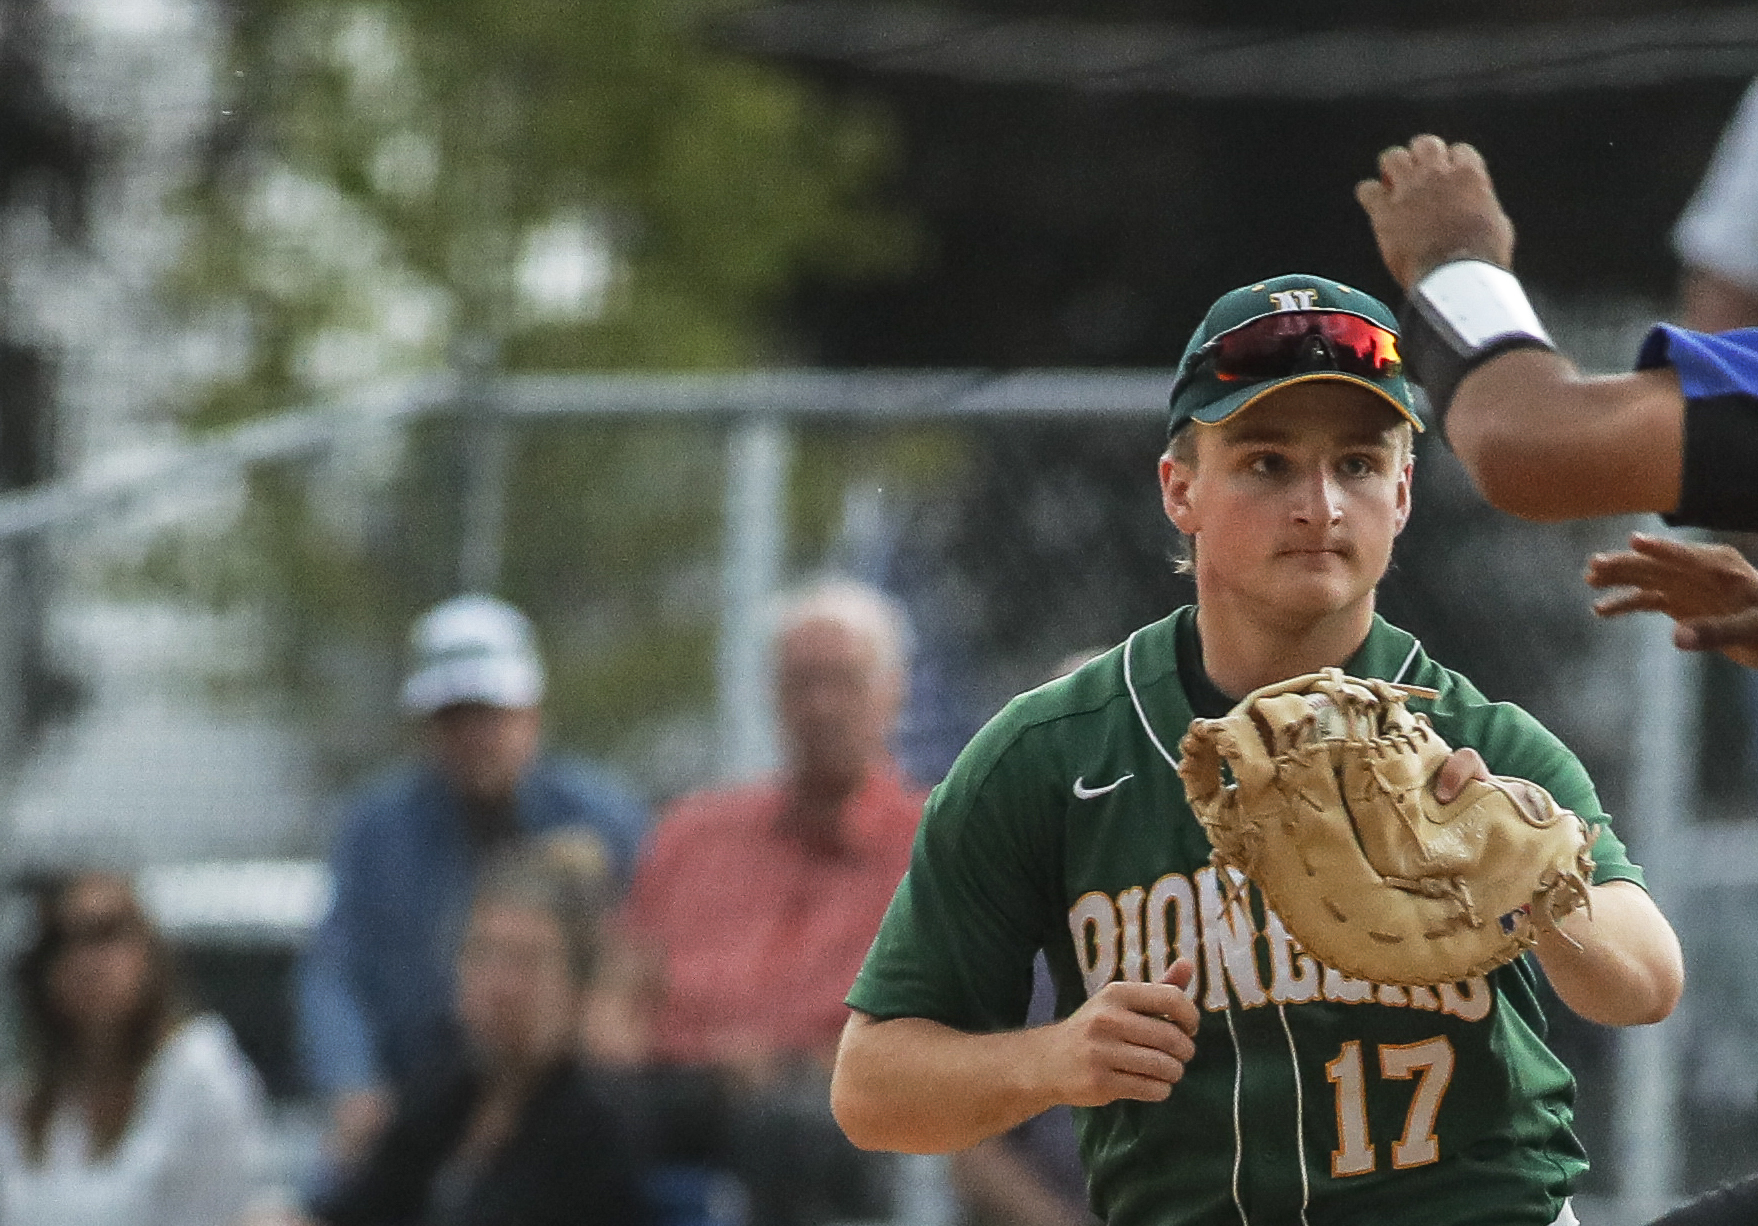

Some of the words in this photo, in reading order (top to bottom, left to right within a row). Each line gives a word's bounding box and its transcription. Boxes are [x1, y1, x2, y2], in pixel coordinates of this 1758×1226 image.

[1269, 287, 1319, 311] N
[1067, 866, 1492, 1023] PIONE
[1324, 1034, 1457, 1178] 17
